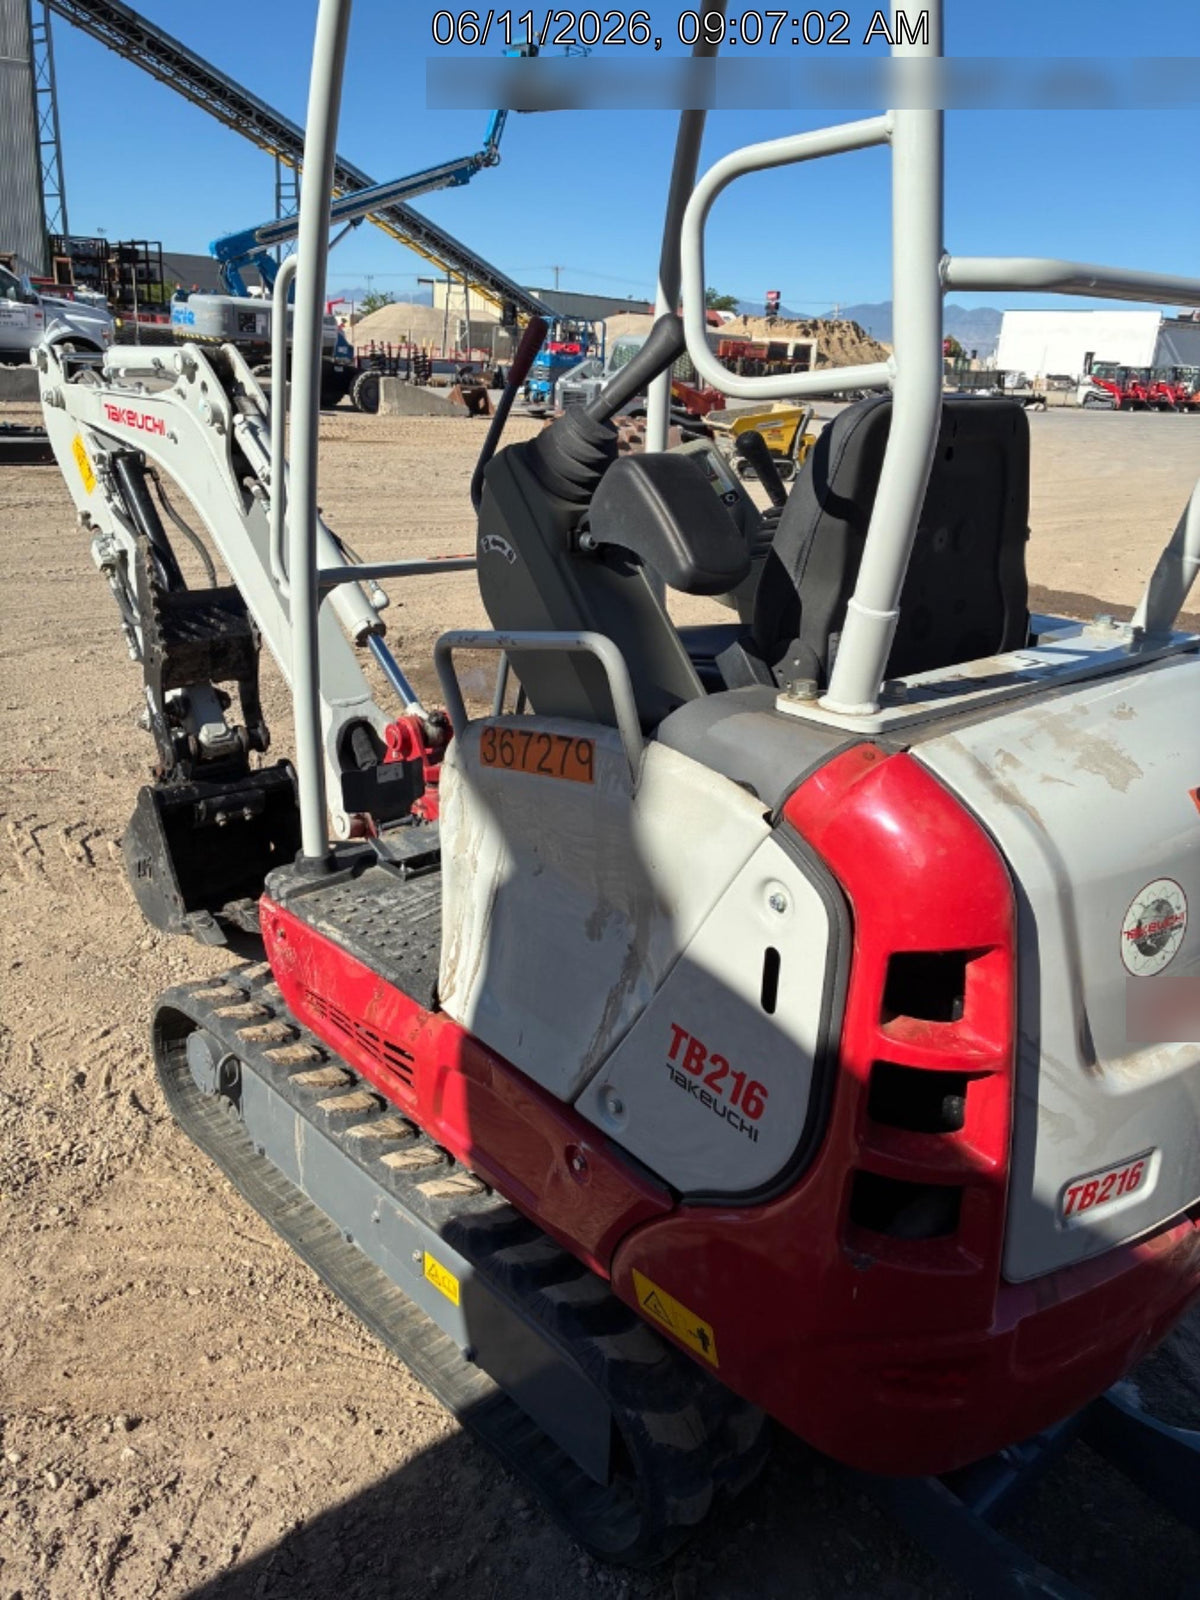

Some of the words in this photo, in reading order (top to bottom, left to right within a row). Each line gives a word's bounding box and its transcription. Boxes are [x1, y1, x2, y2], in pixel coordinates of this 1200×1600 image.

[483, 727, 593, 781] 367279
[668, 1022, 769, 1121] TB216
[1064, 1161, 1145, 1216] TB216
